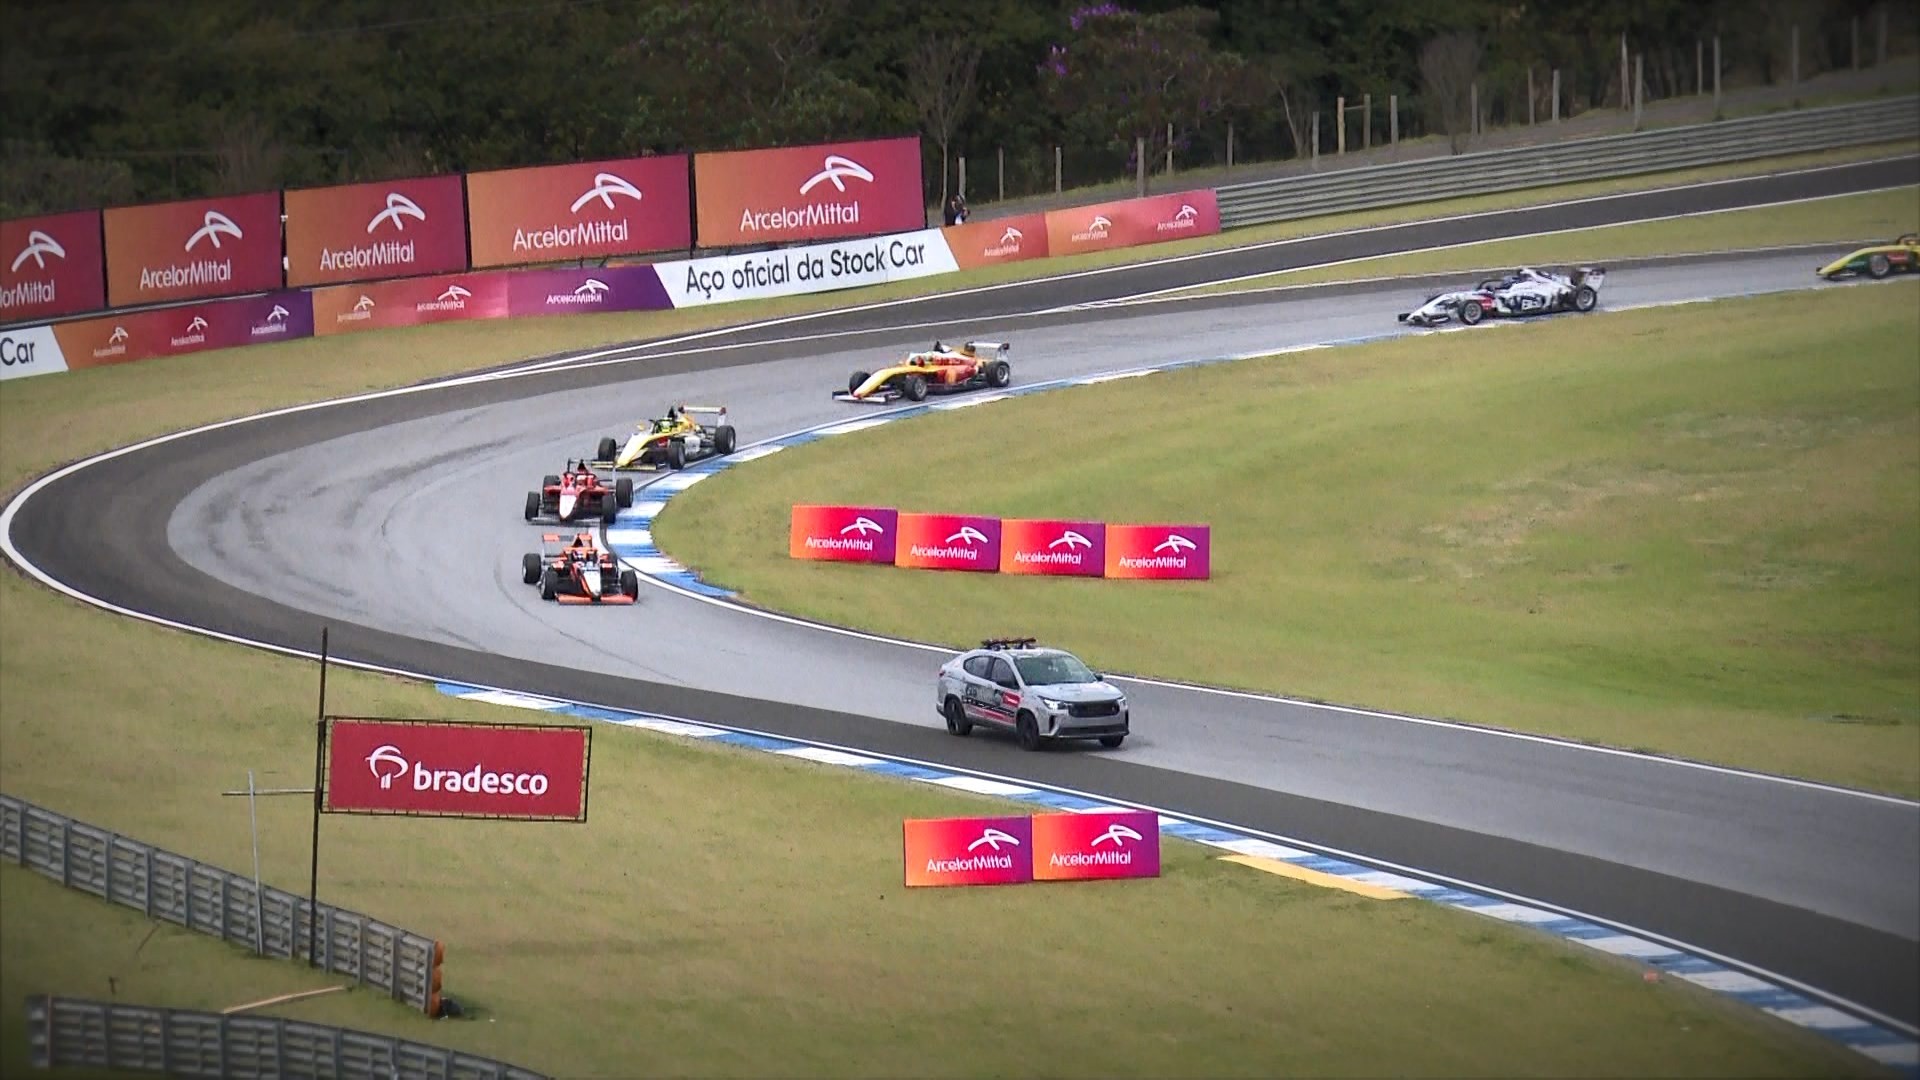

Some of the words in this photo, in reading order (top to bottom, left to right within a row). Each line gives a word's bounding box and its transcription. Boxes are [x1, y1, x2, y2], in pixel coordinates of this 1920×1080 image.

[740, 201, 859, 231] ArcelorMittal
[512, 218, 628, 251] ArcelorMittal
[319, 240, 414, 270] ArcelorMittal
[686, 266, 725, 299] Aço
[732, 260, 790, 288] oficial
[797, 257, 824, 281] da
[831, 244, 886, 275] Stock
[889, 240, 925, 267] Car
[139, 259, 231, 291] ArcelorMittal
[0, 337, 35, 366] Car
[804, 535, 873, 551] ArcelorMittal
[910, 543, 978, 561] ArcelorMittal
[1013, 550, 1082, 565] ArcelorMittal
[1119, 556, 1187, 569] ArcelorMittal
[413, 761, 548, 795] bradesco
[926, 854, 1012, 873] ArcelorMittal
[1049, 851, 1132, 867] ArcelorMittal
